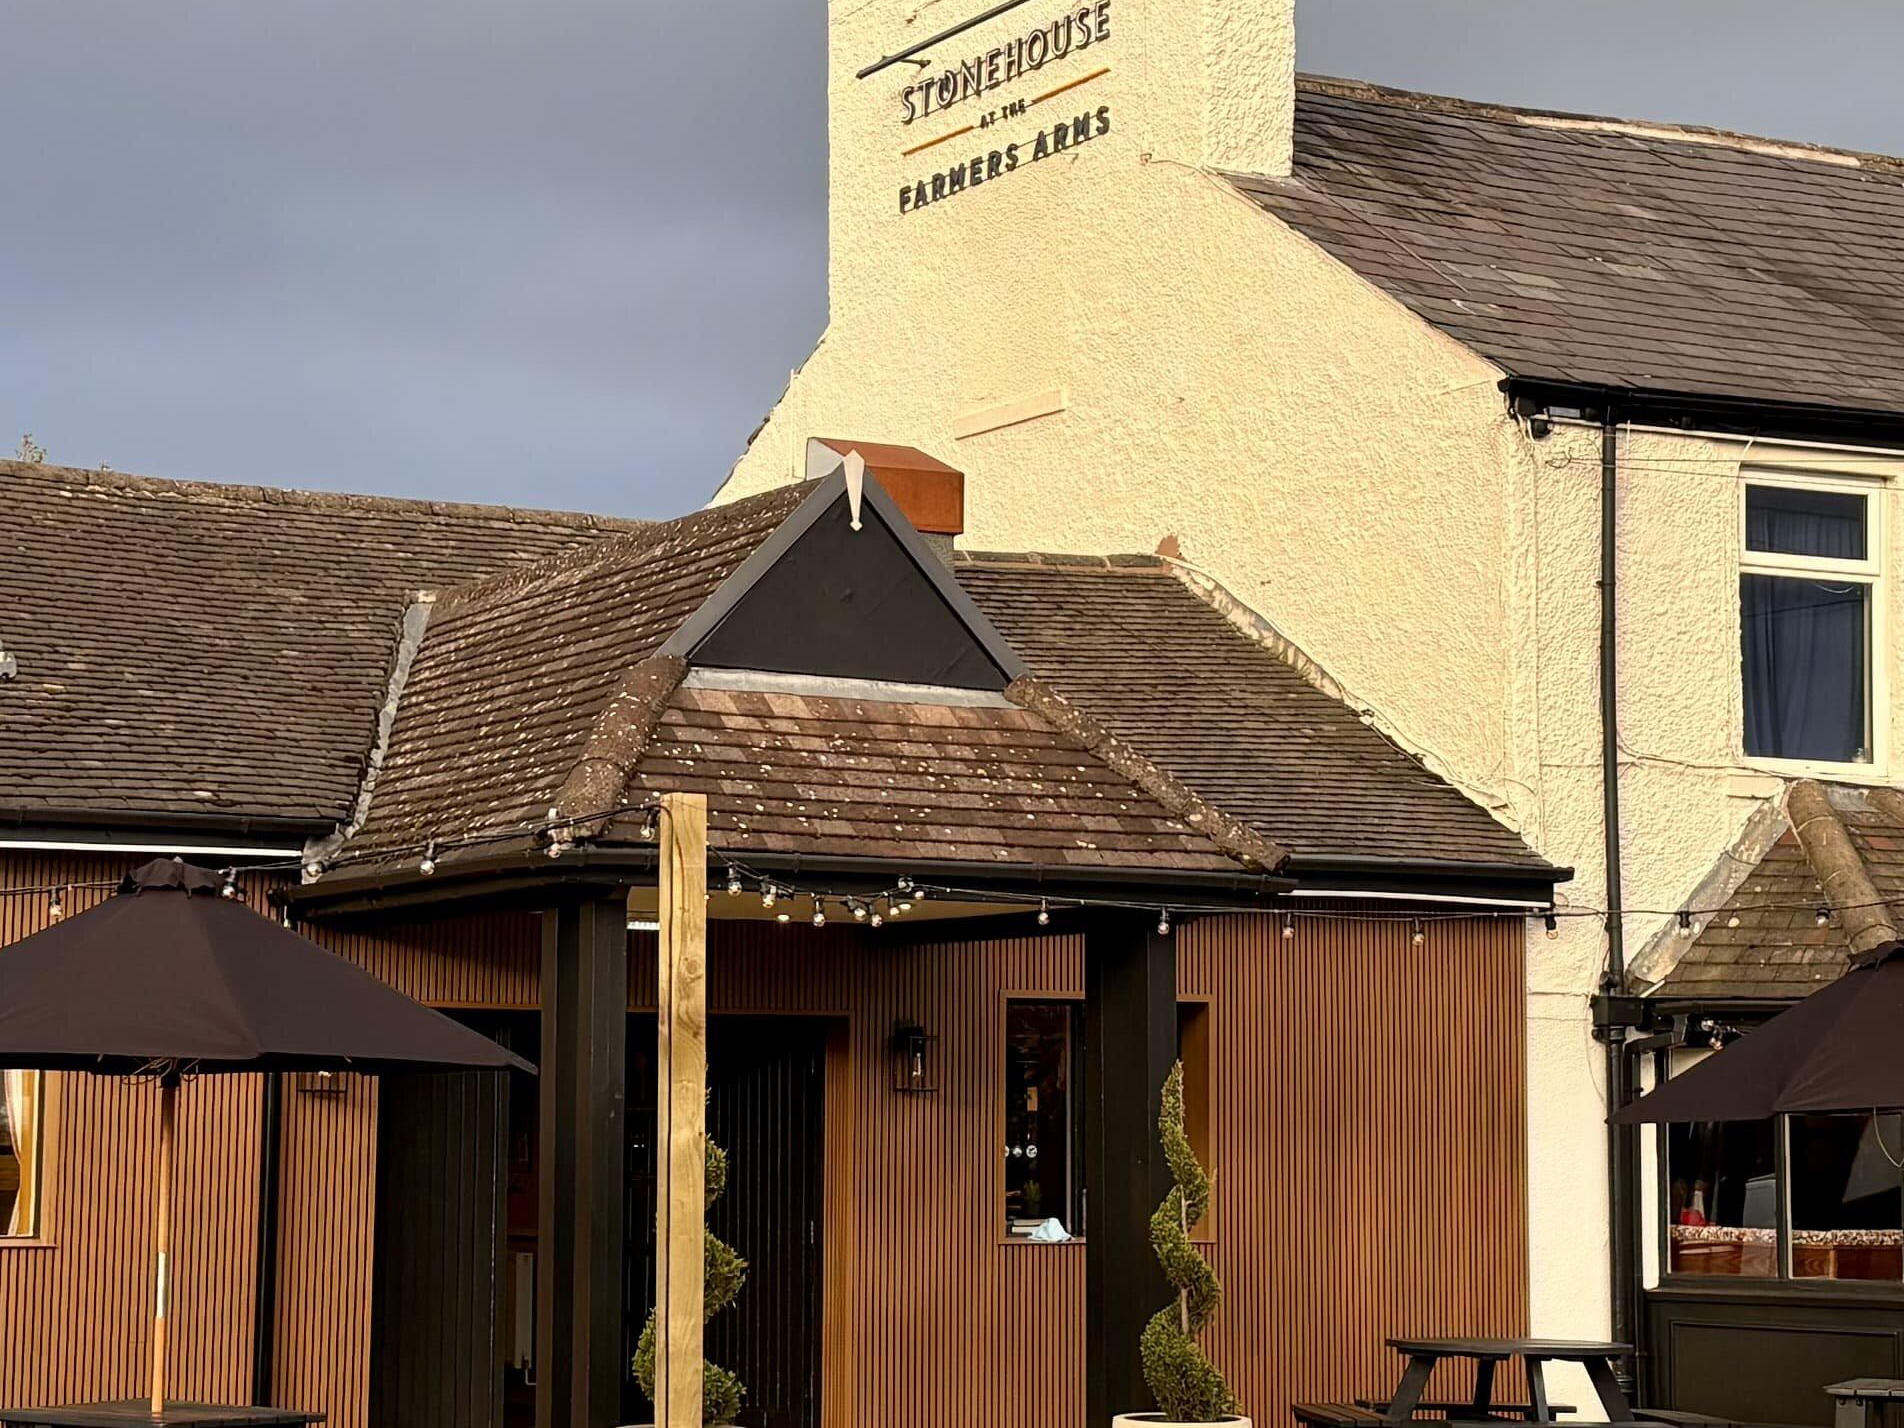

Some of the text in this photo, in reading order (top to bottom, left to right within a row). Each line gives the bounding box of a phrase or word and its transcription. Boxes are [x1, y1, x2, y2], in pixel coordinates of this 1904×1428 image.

[980, 98, 1027, 128] AT THE
[899, 105, 1111, 214] FARMERS ARMS
